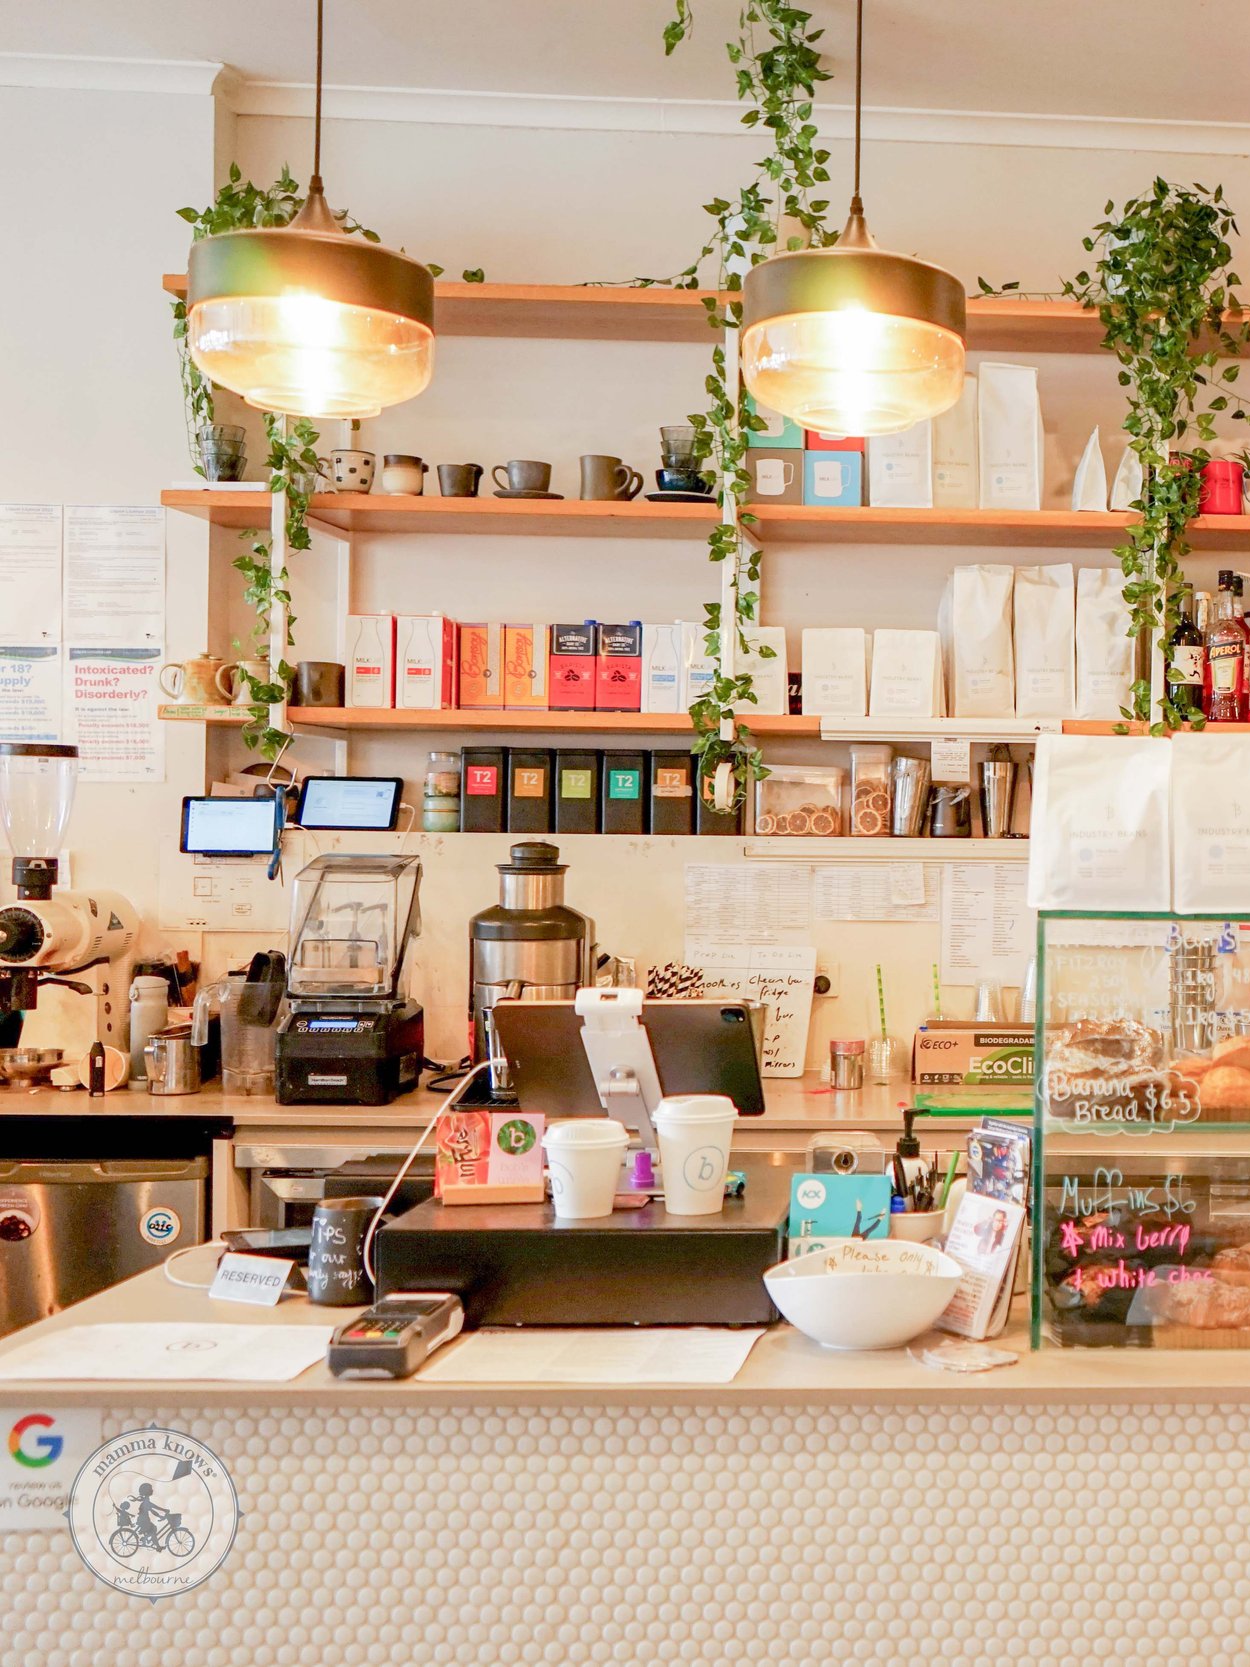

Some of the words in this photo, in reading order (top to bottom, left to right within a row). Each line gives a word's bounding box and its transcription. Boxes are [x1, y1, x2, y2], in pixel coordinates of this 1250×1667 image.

[558, 636, 588, 644] ALTERNATIVE
[605, 636, 634, 644] ALTERNATIVE
[462, 632, 487, 678] Bonsoy
[507, 632, 533, 679] Bonsoy
[1209, 643, 1241, 658] APEROL
[75, 665, 154, 675] Intoxicated?
[0, 677, 31, 687] upply
[75, 677, 120, 687] Drunk?
[75, 689, 148, 701] Disorderly?
[474, 771, 491, 782] T2
[521, 771, 537, 783] T2
[569, 774, 585, 786] T2
[615, 775, 633, 787] T2
[663, 773, 680, 785] T2
[1070, 830, 1114, 839] INDUSTRY
[1118, 830, 1148, 839] BEANS
[1198, 827, 1247, 836] INDUSTRY
[760, 986, 789, 1000] fridge
[969, 1056, 1035, 1075] EcoCli
[1052, 1073, 1133, 1101] Banana
[1075, 1101, 1141, 1123] Bread
[509, 1127, 525, 1147] b
[1058, 1168, 1160, 1217] Muffins
[1164, 1174, 1196, 1220] $6
[1136, 1225, 1191, 1255] berry
[843, 1246, 889, 1261] Please
[221, 1269, 281, 1288] RESERVED
[1099, 1260, 1156, 1289] white
[8, 1413, 64, 1469] G
